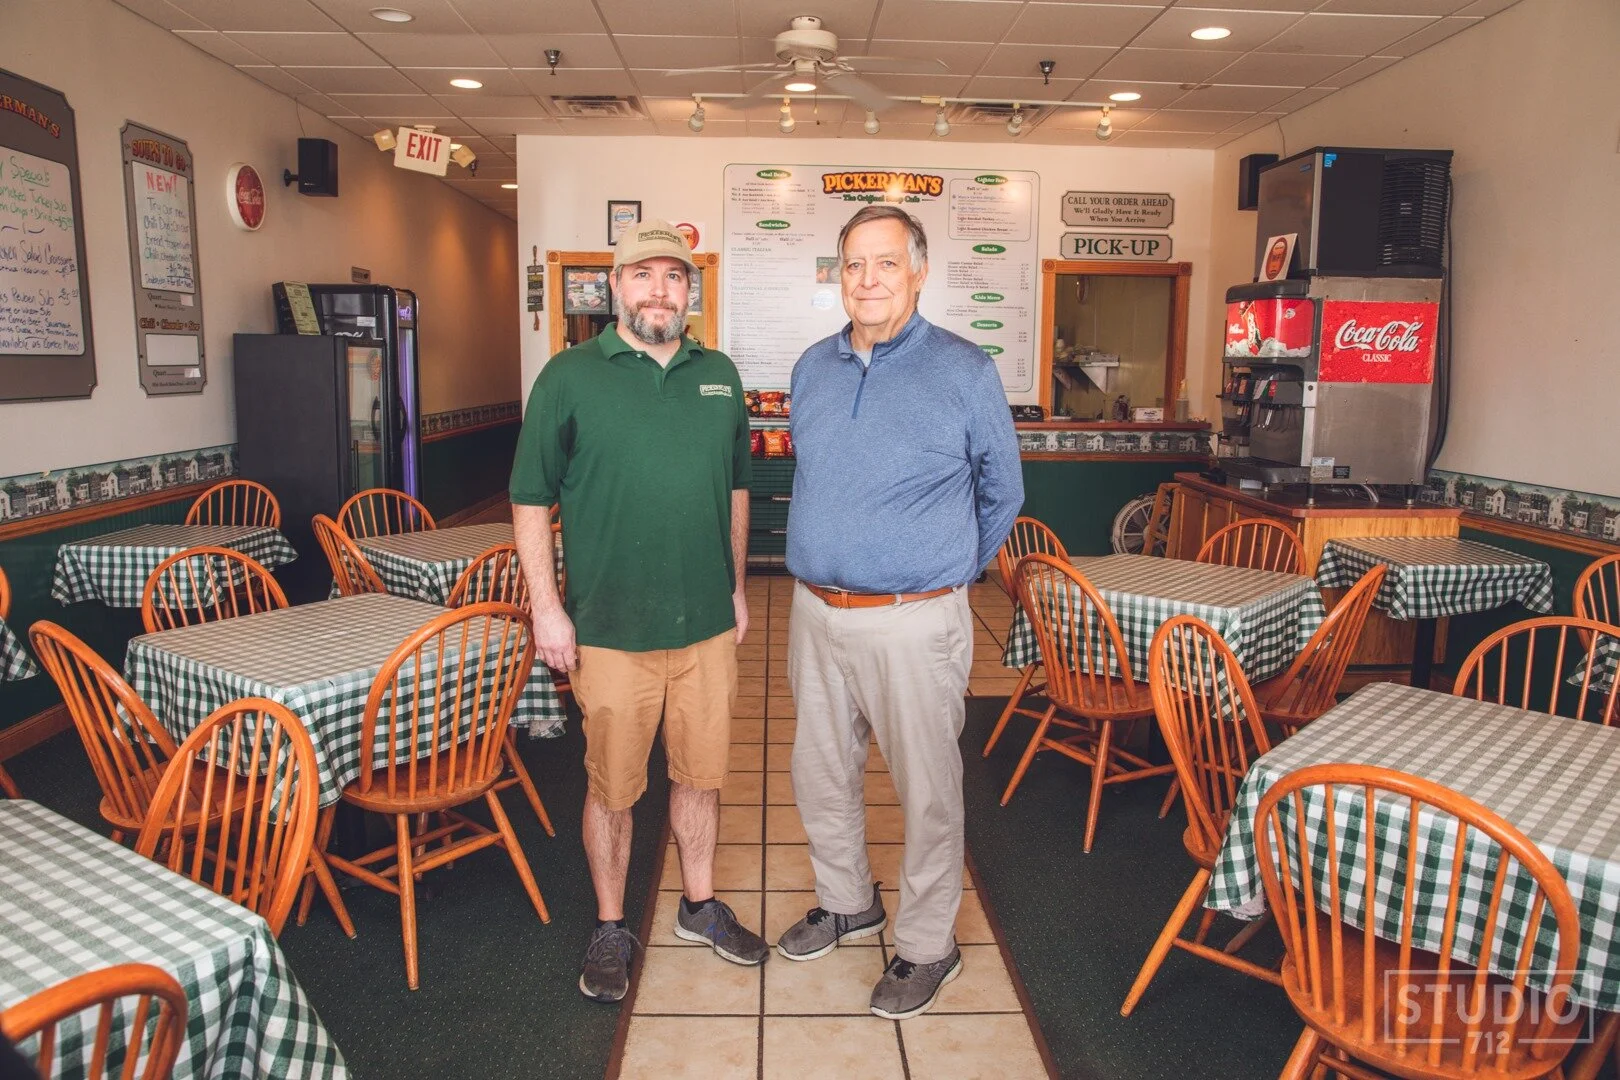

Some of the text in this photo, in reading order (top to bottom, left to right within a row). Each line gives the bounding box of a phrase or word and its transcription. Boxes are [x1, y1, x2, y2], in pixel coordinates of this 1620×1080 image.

[132, 139, 186, 171] SOUPS TO GO
[406, 132, 442, 163] EXIT
[145, 171, 177, 198] NEW!
[822, 172, 943, 196] PICKERMAN'S
[843, 193, 857, 202] The
[857, 194, 885, 204] Original
[905, 195, 920, 203] Cafe
[1067, 196, 1169, 207] CALL YOUR ORDER AHEAD
[1092, 207, 1114, 216] Gladly
[1141, 209, 1162, 217] Ready
[1073, 238, 1160, 256] PICK-UP
[140, 317, 156, 329] Chili
[1335, 319, 1424, 352] Coca-Cola
[1362, 354, 1392, 363] CLASSIC
